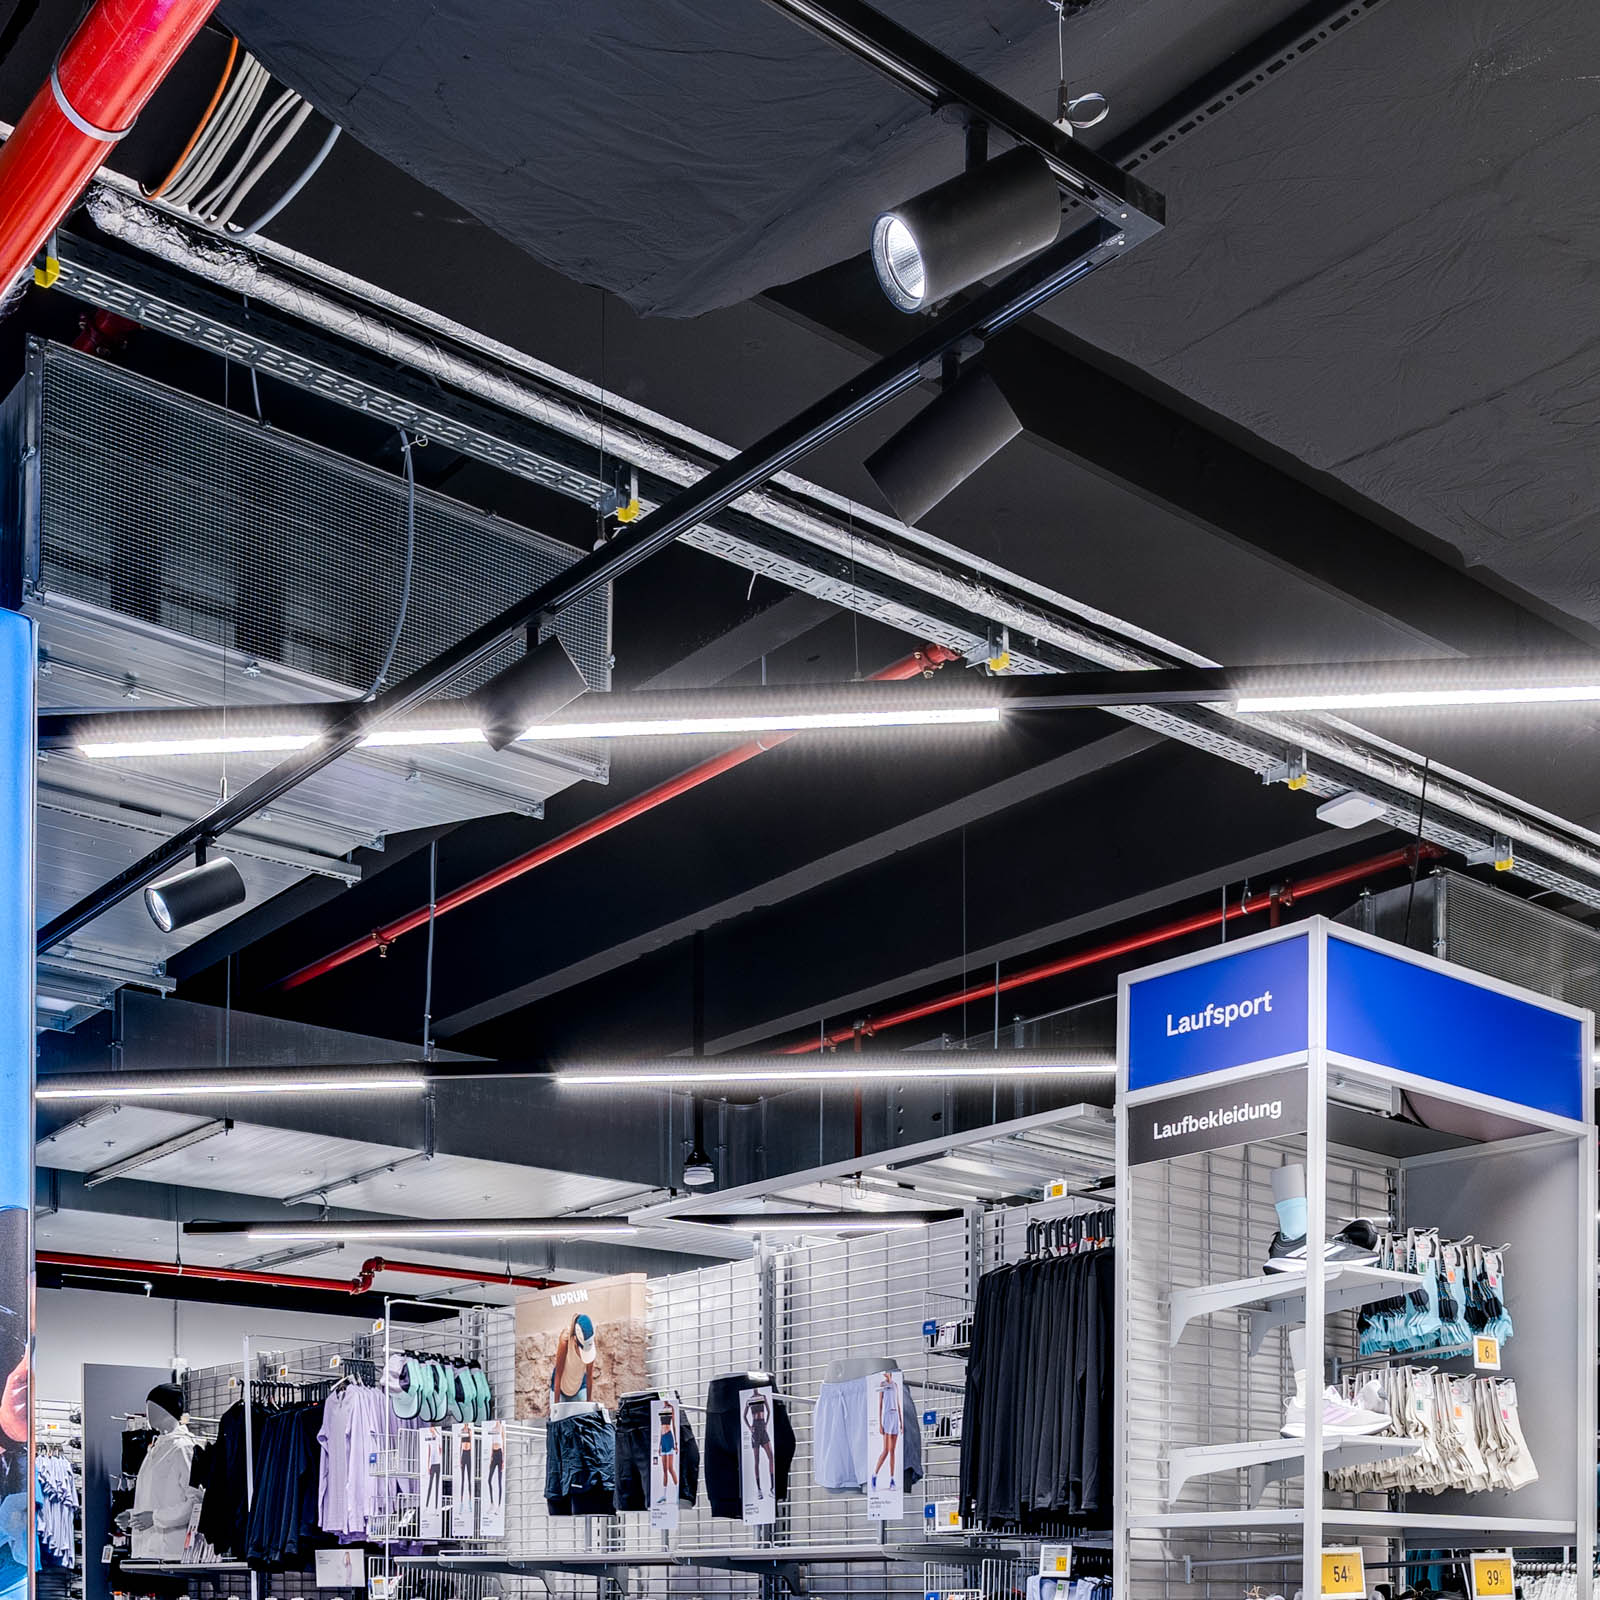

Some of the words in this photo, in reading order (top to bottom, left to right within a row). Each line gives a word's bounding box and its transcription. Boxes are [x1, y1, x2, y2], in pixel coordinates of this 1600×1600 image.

[1166, 990, 1273, 1037] Laufsport
[1153, 1098, 1282, 1140] Laufbekleidung
[551, 1289, 588, 1307] KIPRUN
